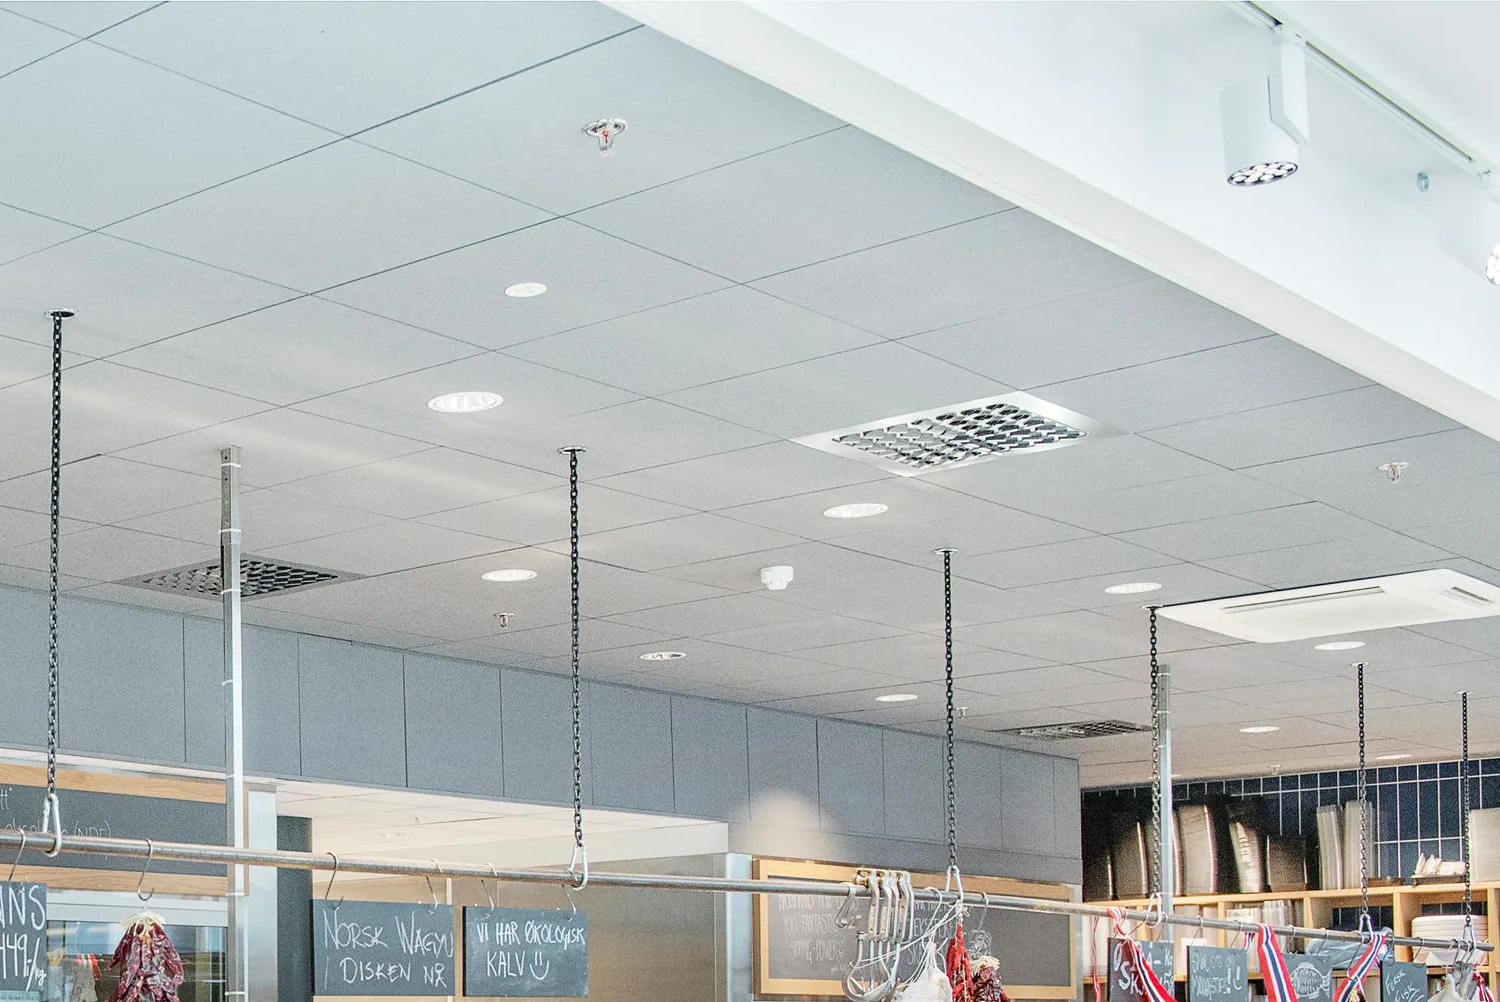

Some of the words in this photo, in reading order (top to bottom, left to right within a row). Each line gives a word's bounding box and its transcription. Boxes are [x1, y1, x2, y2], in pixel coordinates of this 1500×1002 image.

[323, 908, 388, 950] NORSK
[395, 910, 454, 959] WAGYU
[477, 923, 490, 945] VI
[496, 921, 521, 946] HAR
[340, 957, 411, 985] DISKEN
[486, 950, 526, 979] KALV
